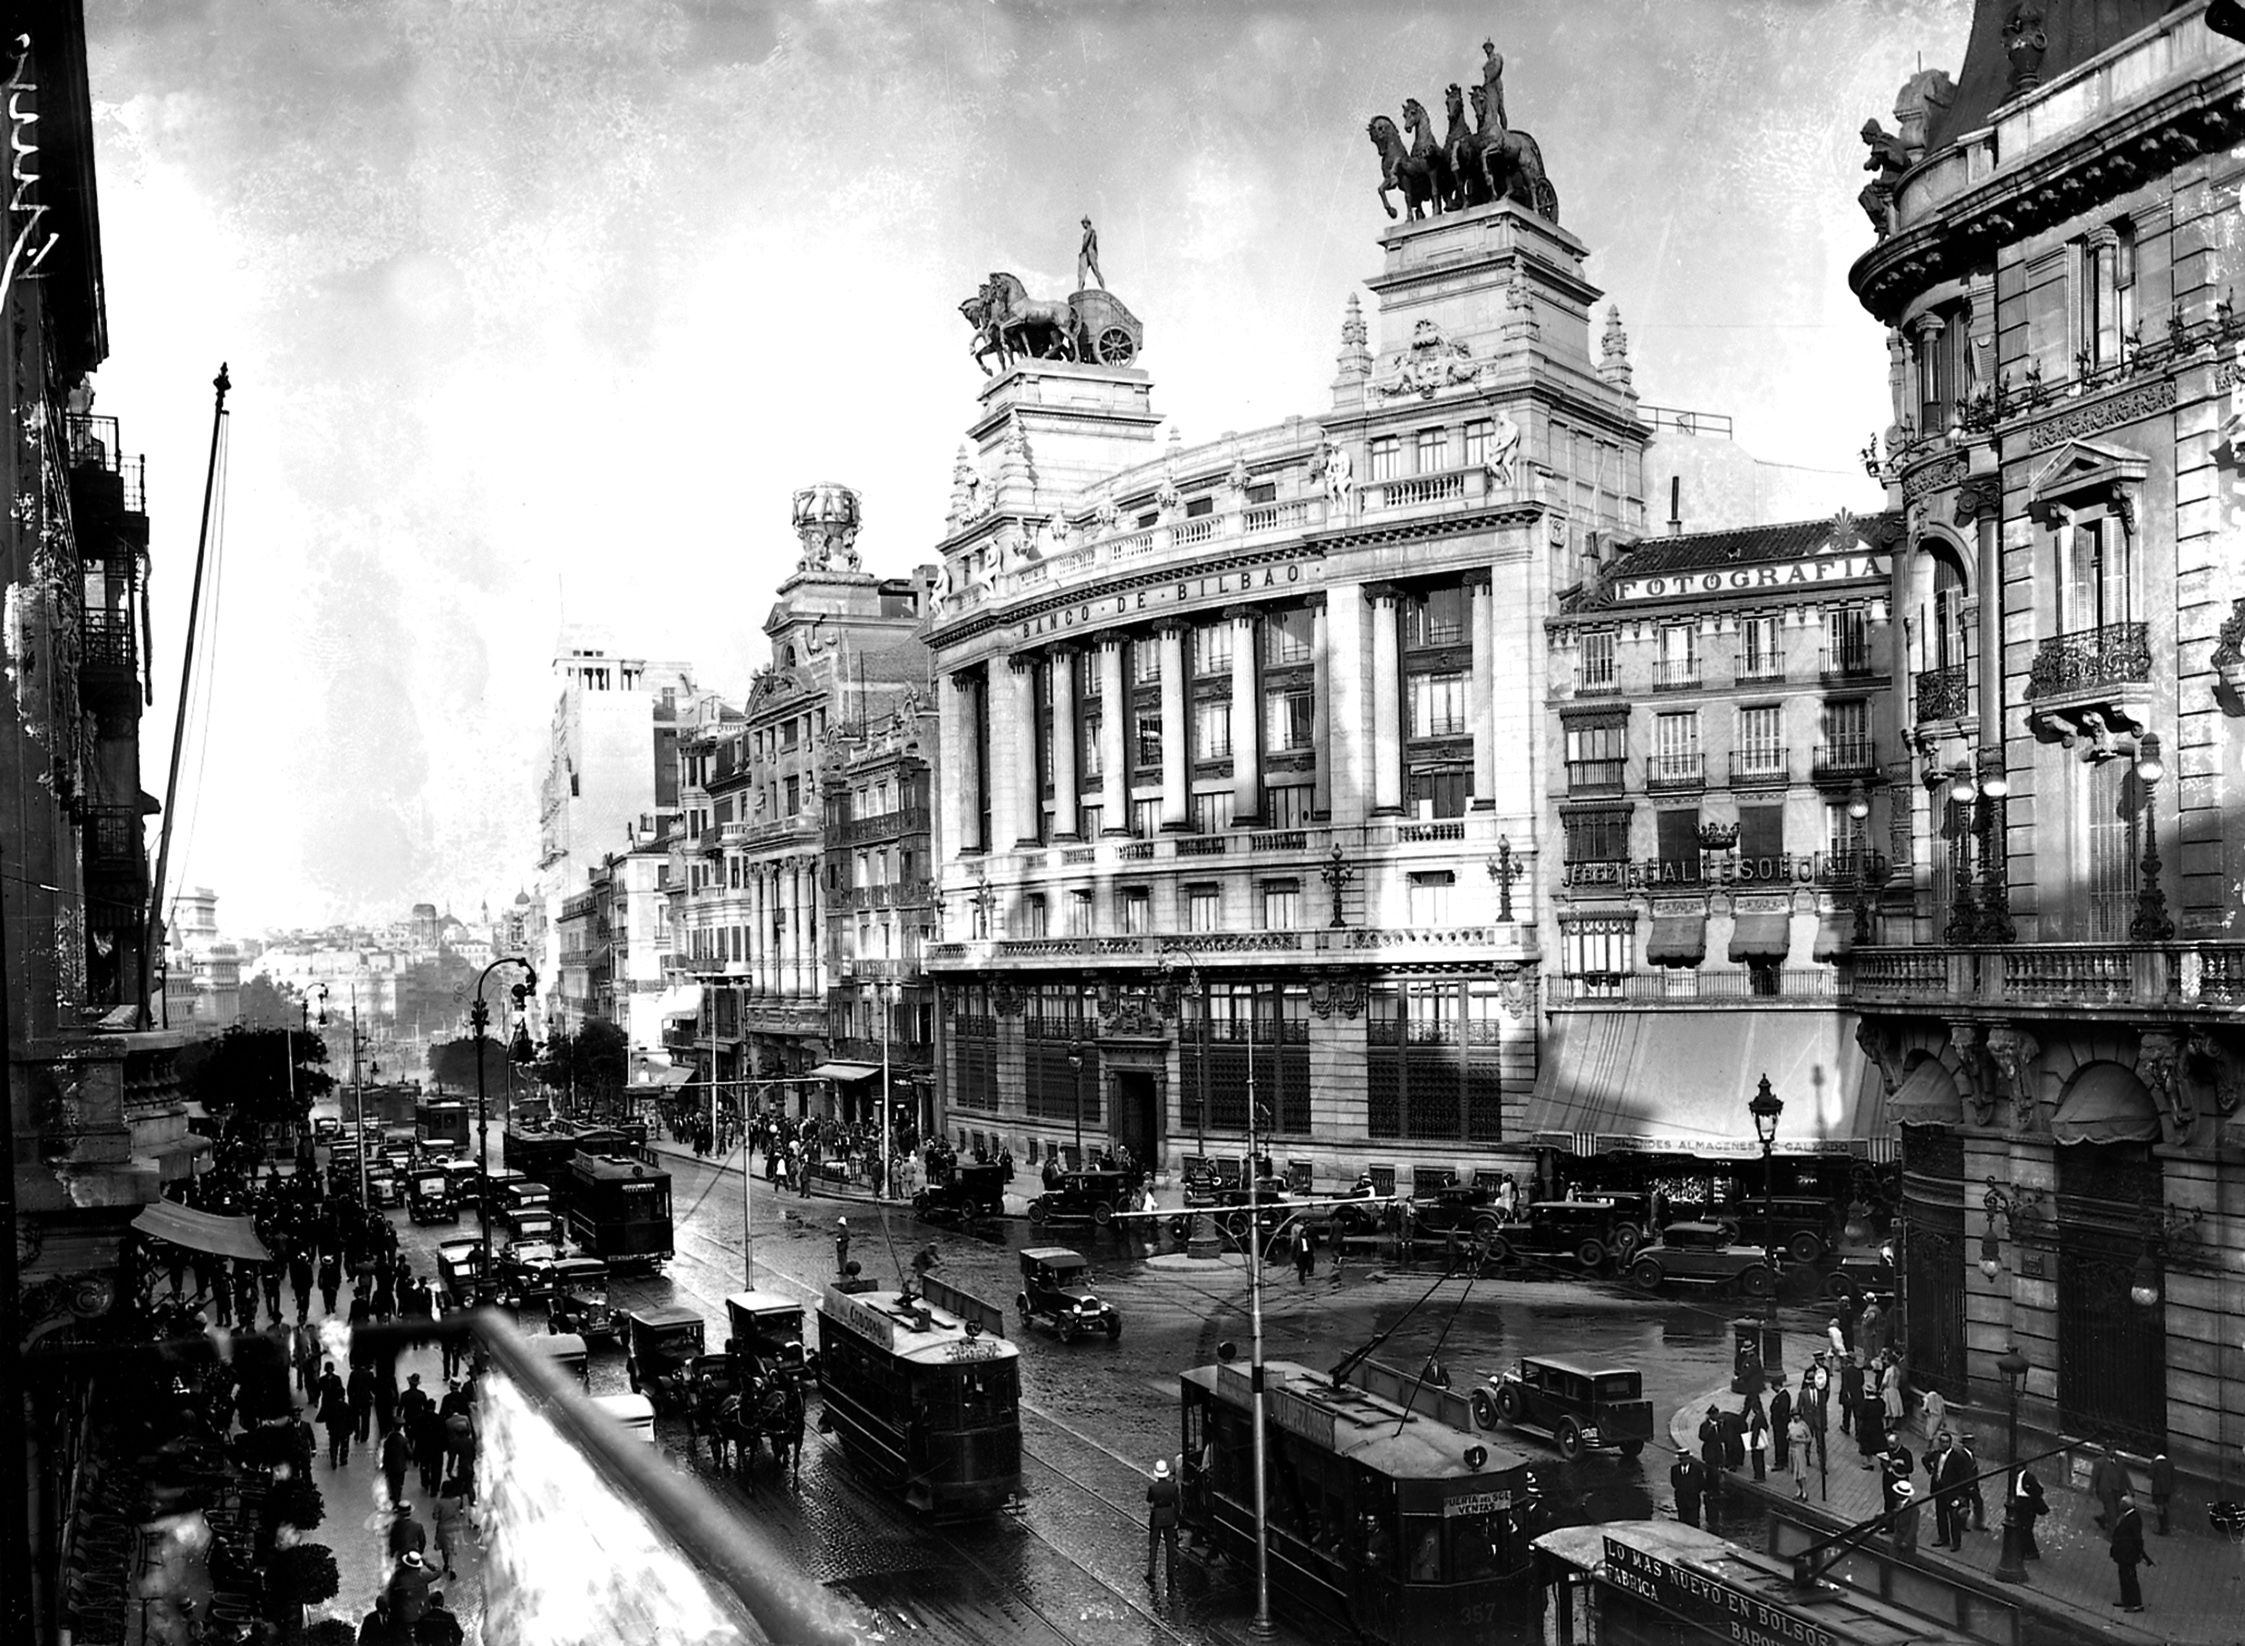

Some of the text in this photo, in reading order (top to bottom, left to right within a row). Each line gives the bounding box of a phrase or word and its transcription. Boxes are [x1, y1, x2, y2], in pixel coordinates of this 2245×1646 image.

[1618, 557, 1882, 599] FOTOGRAFIA
[1023, 564, 1299, 638] BANCO DE BILBAO
[1678, 1140, 1756, 1152] ALMACENES
[1458, 1502, 1496, 1514] VENTAS
[1606, 1563, 1659, 1601] FABRICA
[1607, 1539, 1829, 1646] LO MAS NUEVO EN BOLSOS
